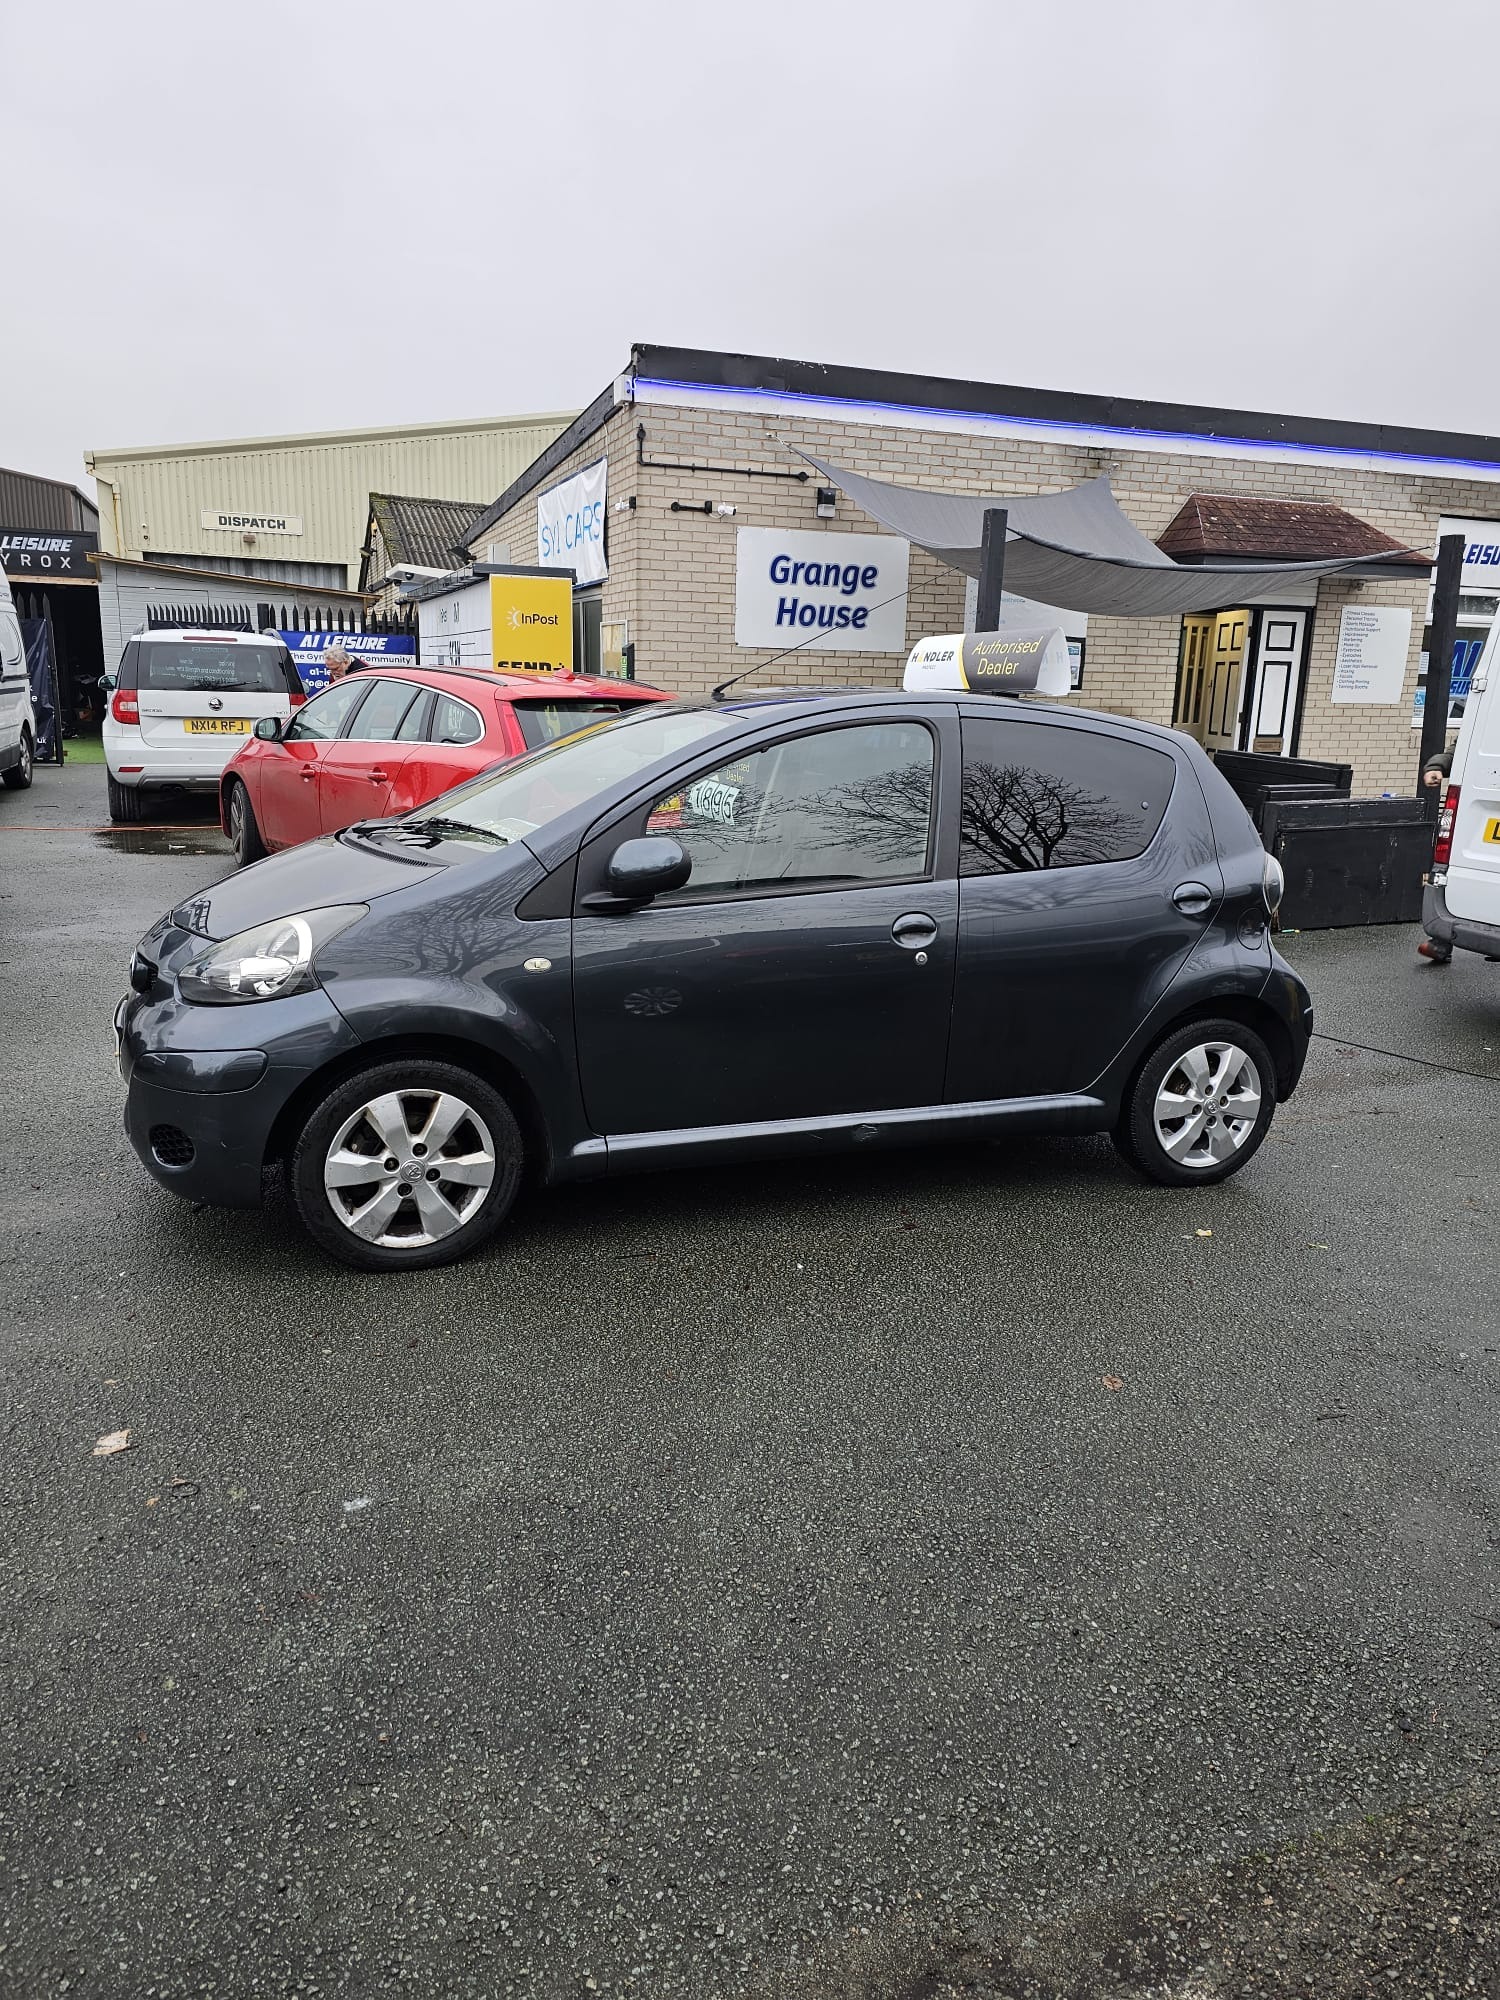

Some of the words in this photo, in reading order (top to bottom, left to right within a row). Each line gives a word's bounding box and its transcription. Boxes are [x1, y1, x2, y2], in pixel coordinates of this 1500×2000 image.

[218, 515, 286, 530] DISPATCH
[565, 501, 602, 549] CARS
[1, 536, 73, 552] LEISURE
[0, 552, 72, 569] YROX
[1463, 543, 1500, 566] EISU
[769, 554, 878, 595] Grange
[521, 613, 559, 626] InPost
[776, 597, 869, 629] House
[323, 635, 388, 651] LEISURE
[972, 635, 1043, 656] Authorised
[977, 658, 1020, 675] Dealer
[191, 720, 217, 731] NX14
[221, 721, 244, 731] RFJ
[695, 785, 734, 819] 1895
